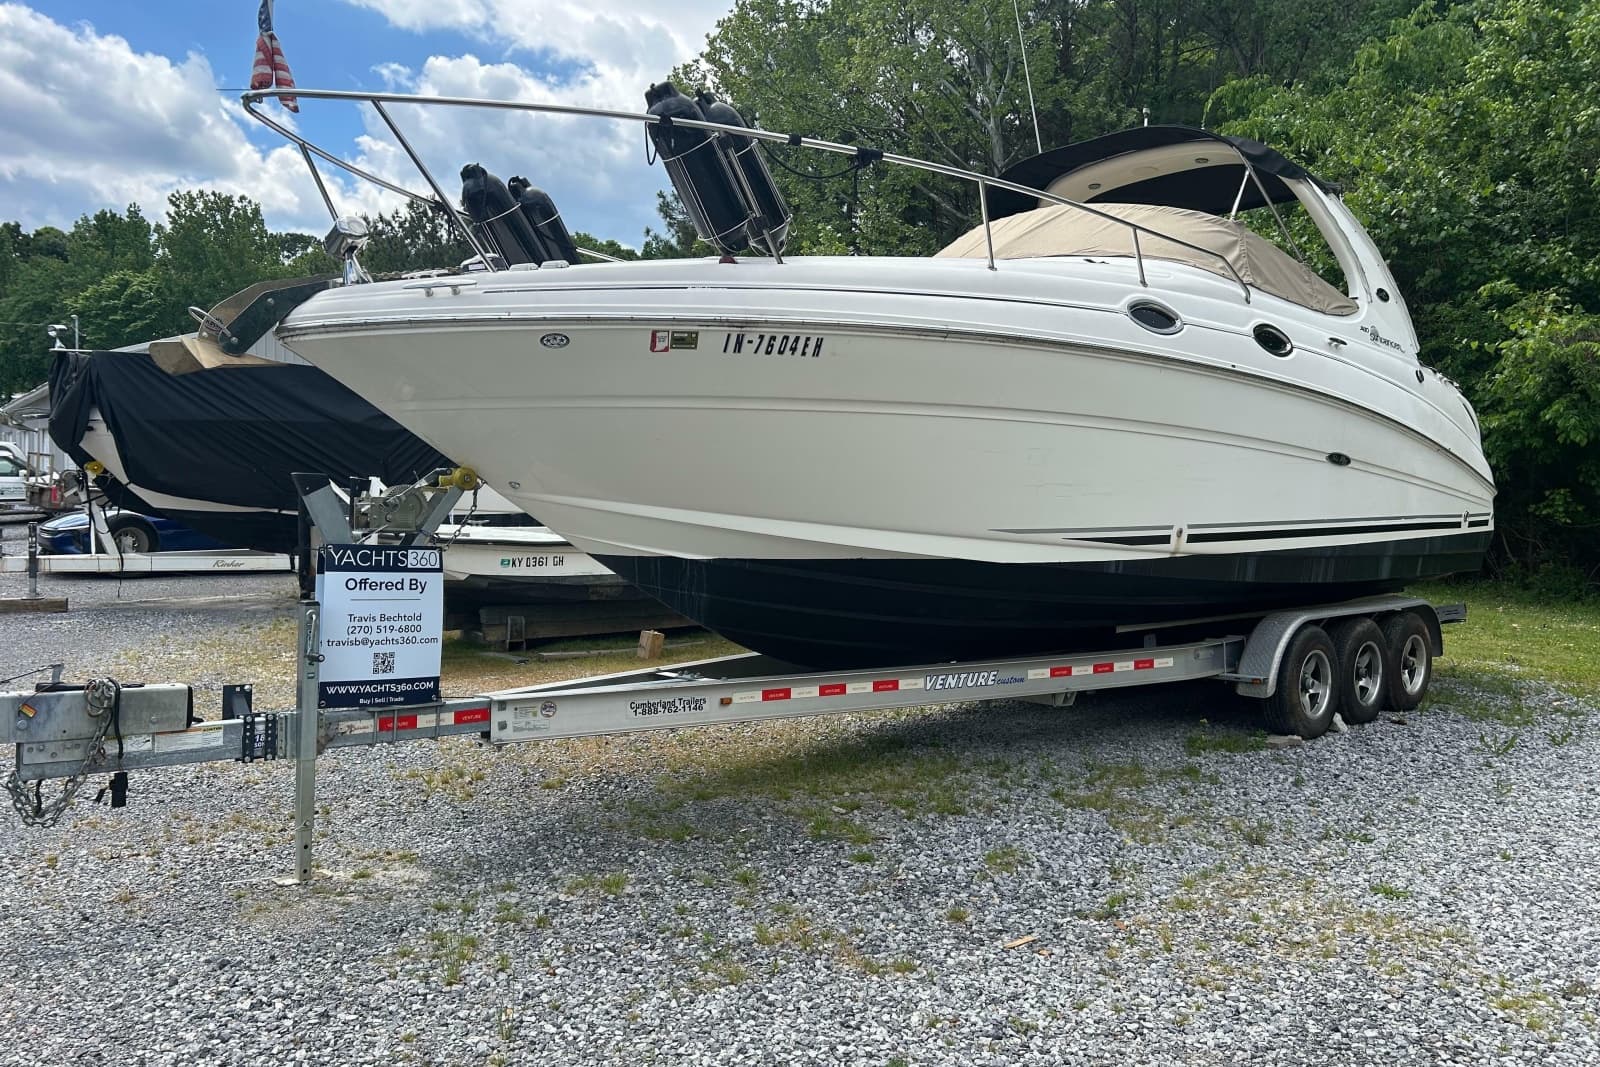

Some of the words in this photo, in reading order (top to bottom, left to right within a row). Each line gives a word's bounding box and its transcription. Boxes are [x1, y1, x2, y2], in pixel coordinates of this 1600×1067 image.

[511, 557, 523, 568] KY
[526, 556, 548, 567] 0361
[553, 555, 564, 567] GH
[345, 577, 405, 591] Offered
[409, 578, 427, 594] By
[348, 613, 377, 623] Travis
[379, 612, 422, 622] Bechtold
[346, 625, 373, 635] (270)
[376, 624, 422, 634] 519-6800
[327, 636, 438, 648] travisb@yachts360.com
[924, 669, 999, 691] VENTURE
[997, 676, 1025, 685] custom
[326, 681, 434, 694] WWW.YACHTS360.COM
[629, 699, 676, 710] Cumberland
[678, 697, 707, 706] Trailers
[632, 704, 704, 716] 1-888-762-1146
